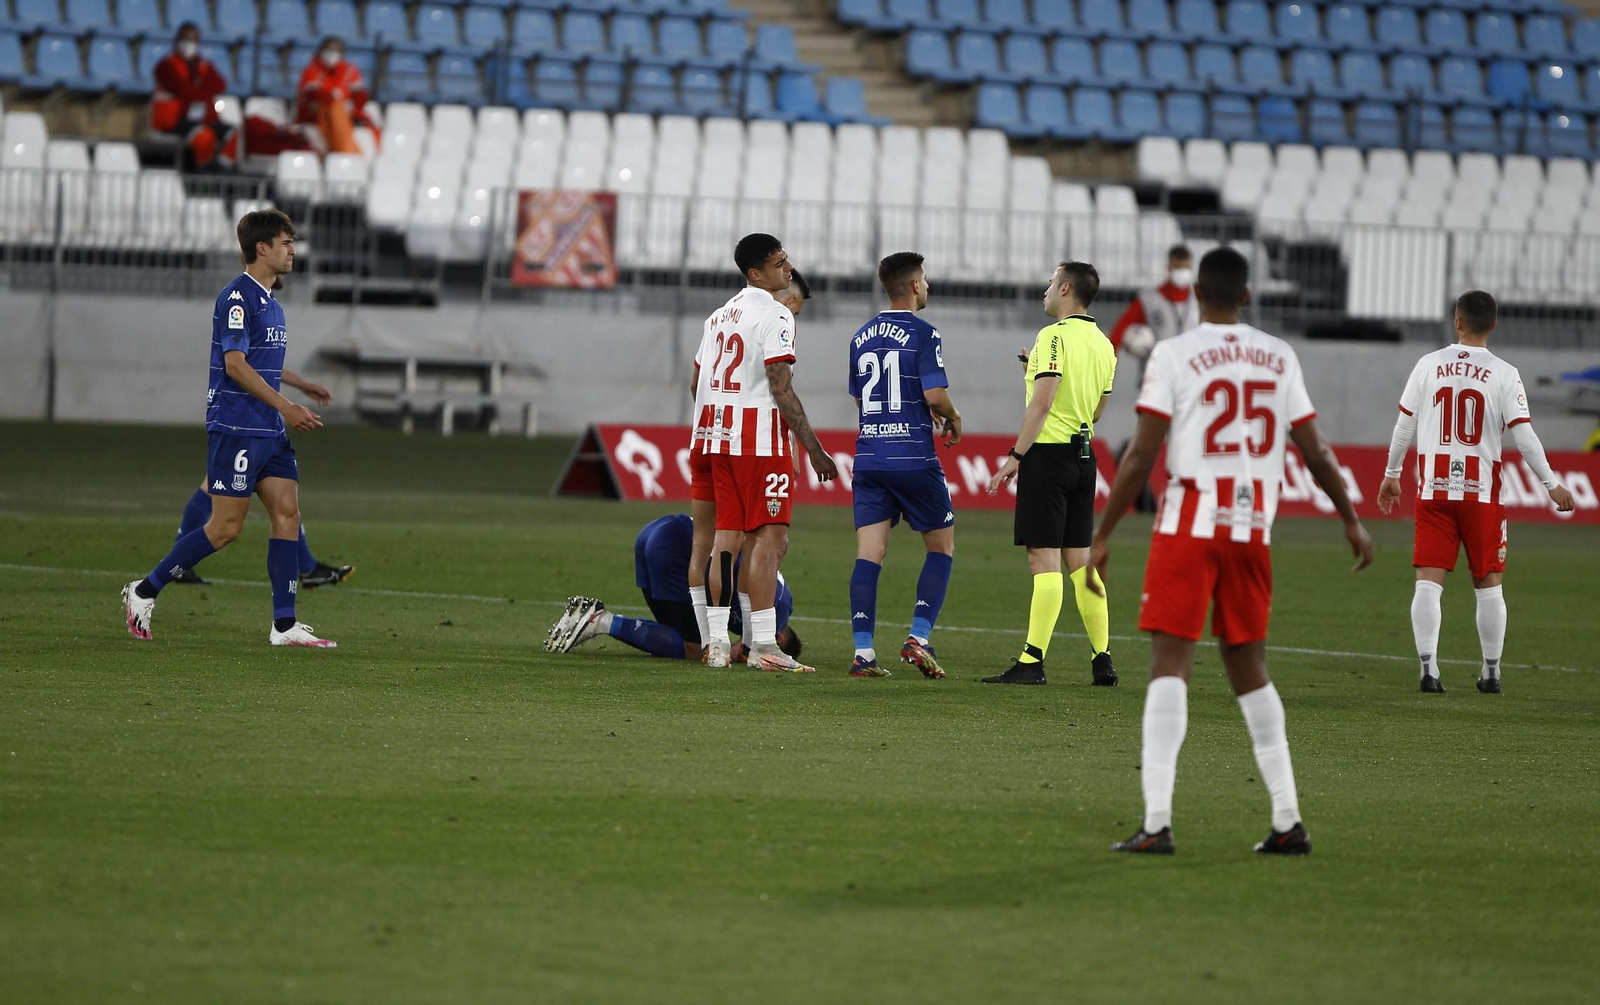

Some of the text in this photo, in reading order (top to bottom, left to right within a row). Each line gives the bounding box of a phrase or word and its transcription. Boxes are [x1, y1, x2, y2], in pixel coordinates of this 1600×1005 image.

[854, 322, 911, 349] DANI OJEDA
[710, 330, 744, 393] 22
[1189, 345, 1286, 375] FERNANDES
[1436, 362, 1492, 383] AKETXE
[857, 350, 902, 416] 21
[1201, 378, 1277, 458] 25
[1433, 386, 1485, 447] 10
[233, 448, 249, 473] 6
[764, 473, 790, 498] 22
